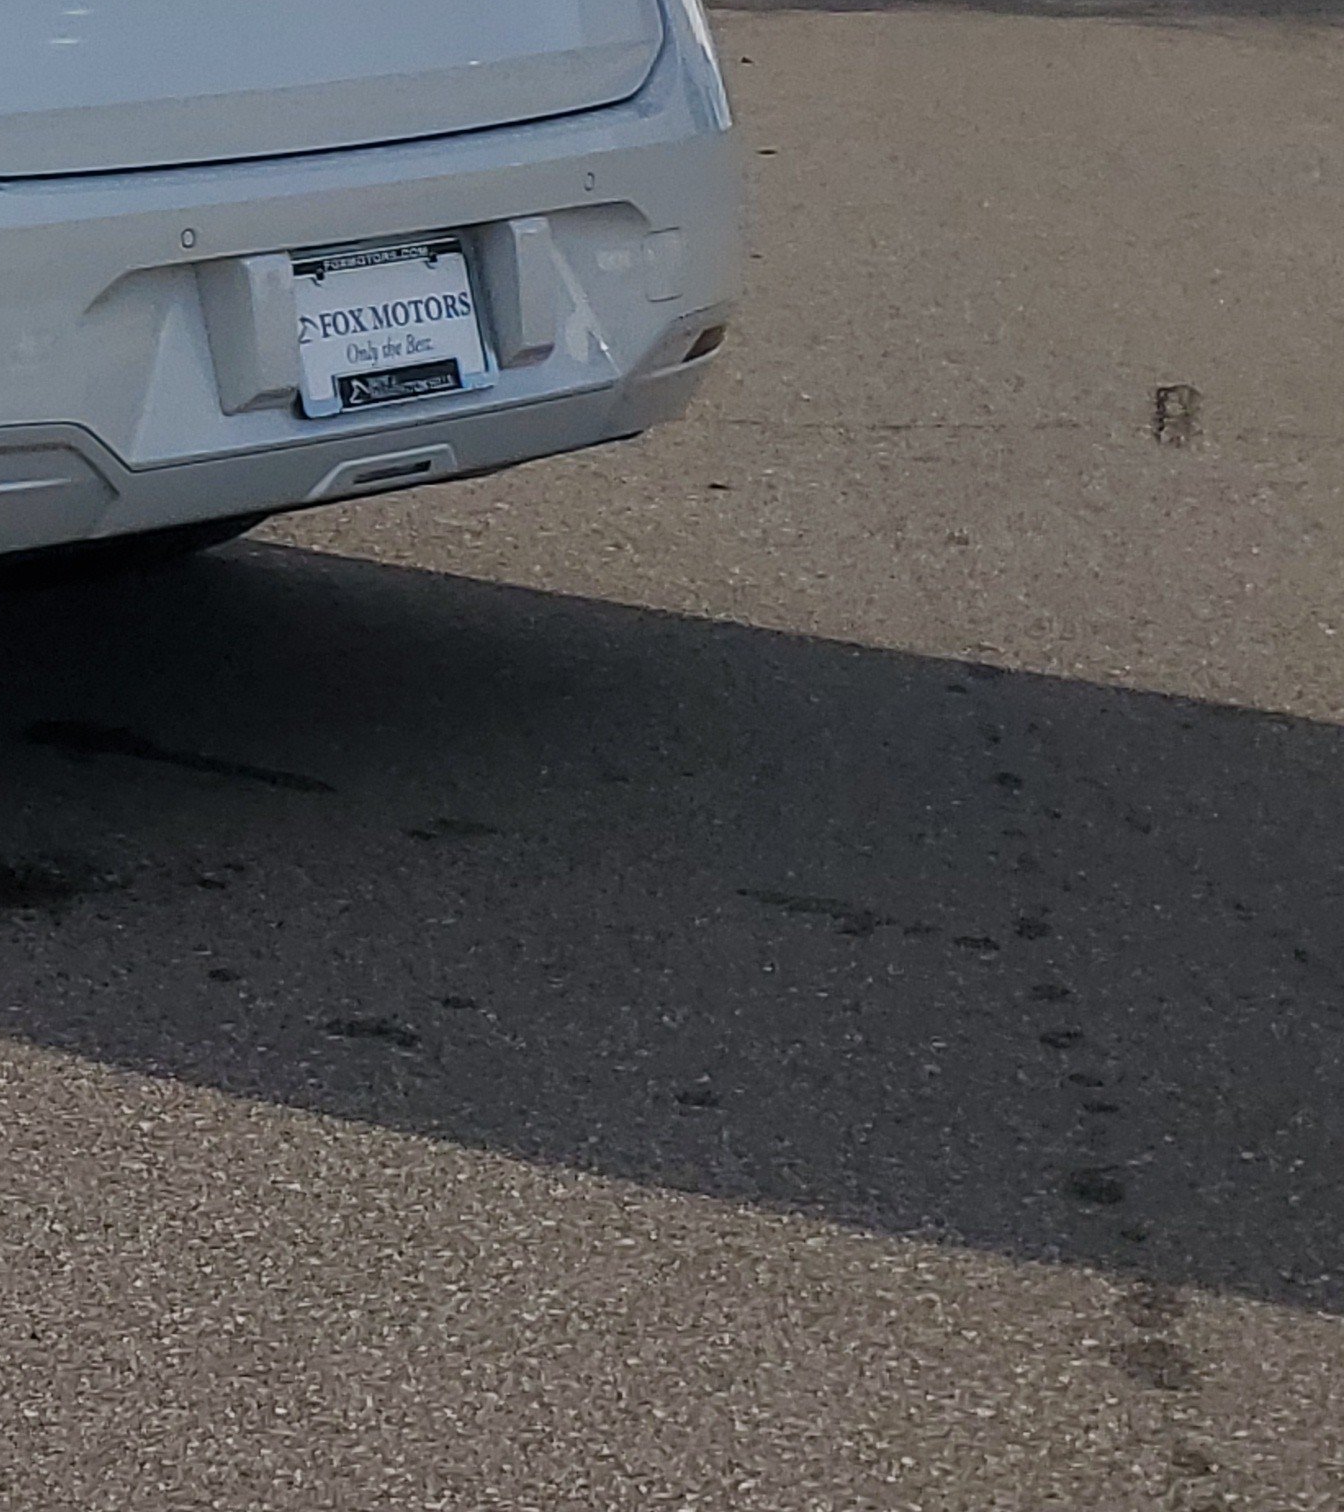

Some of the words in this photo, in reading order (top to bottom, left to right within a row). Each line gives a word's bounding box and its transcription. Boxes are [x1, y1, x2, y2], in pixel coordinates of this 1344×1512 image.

[319, 306, 368, 339] FOX
[368, 291, 472, 330] MOTORS
[346, 340, 379, 366] Only
[381, 336, 402, 359] the
